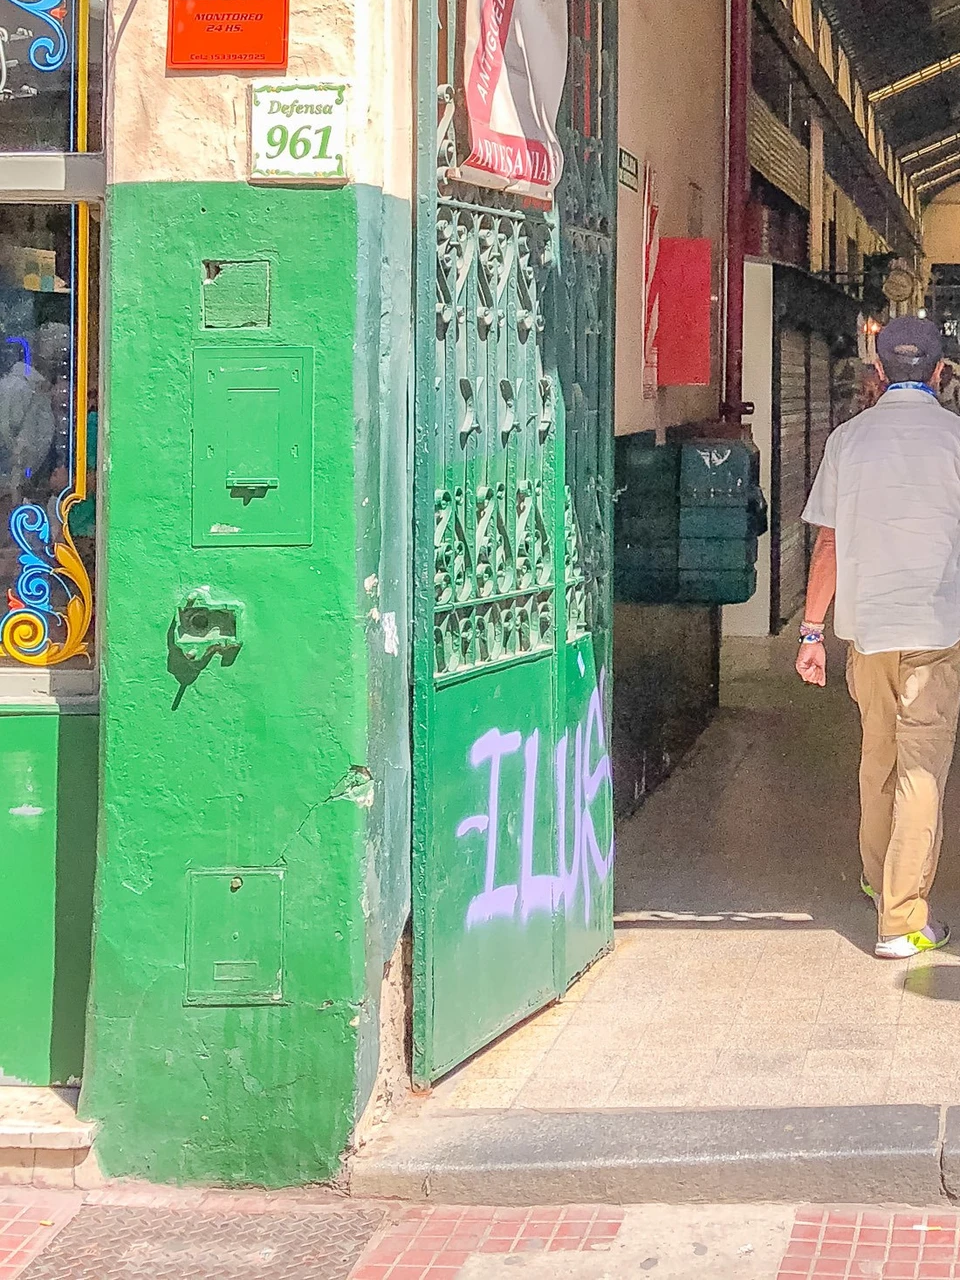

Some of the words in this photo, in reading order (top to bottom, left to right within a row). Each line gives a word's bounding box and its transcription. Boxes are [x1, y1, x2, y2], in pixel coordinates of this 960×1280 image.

[206, 24, 222, 32] 24
[267, 100, 333, 118] Defensa
[266, 124, 333, 159] 961
